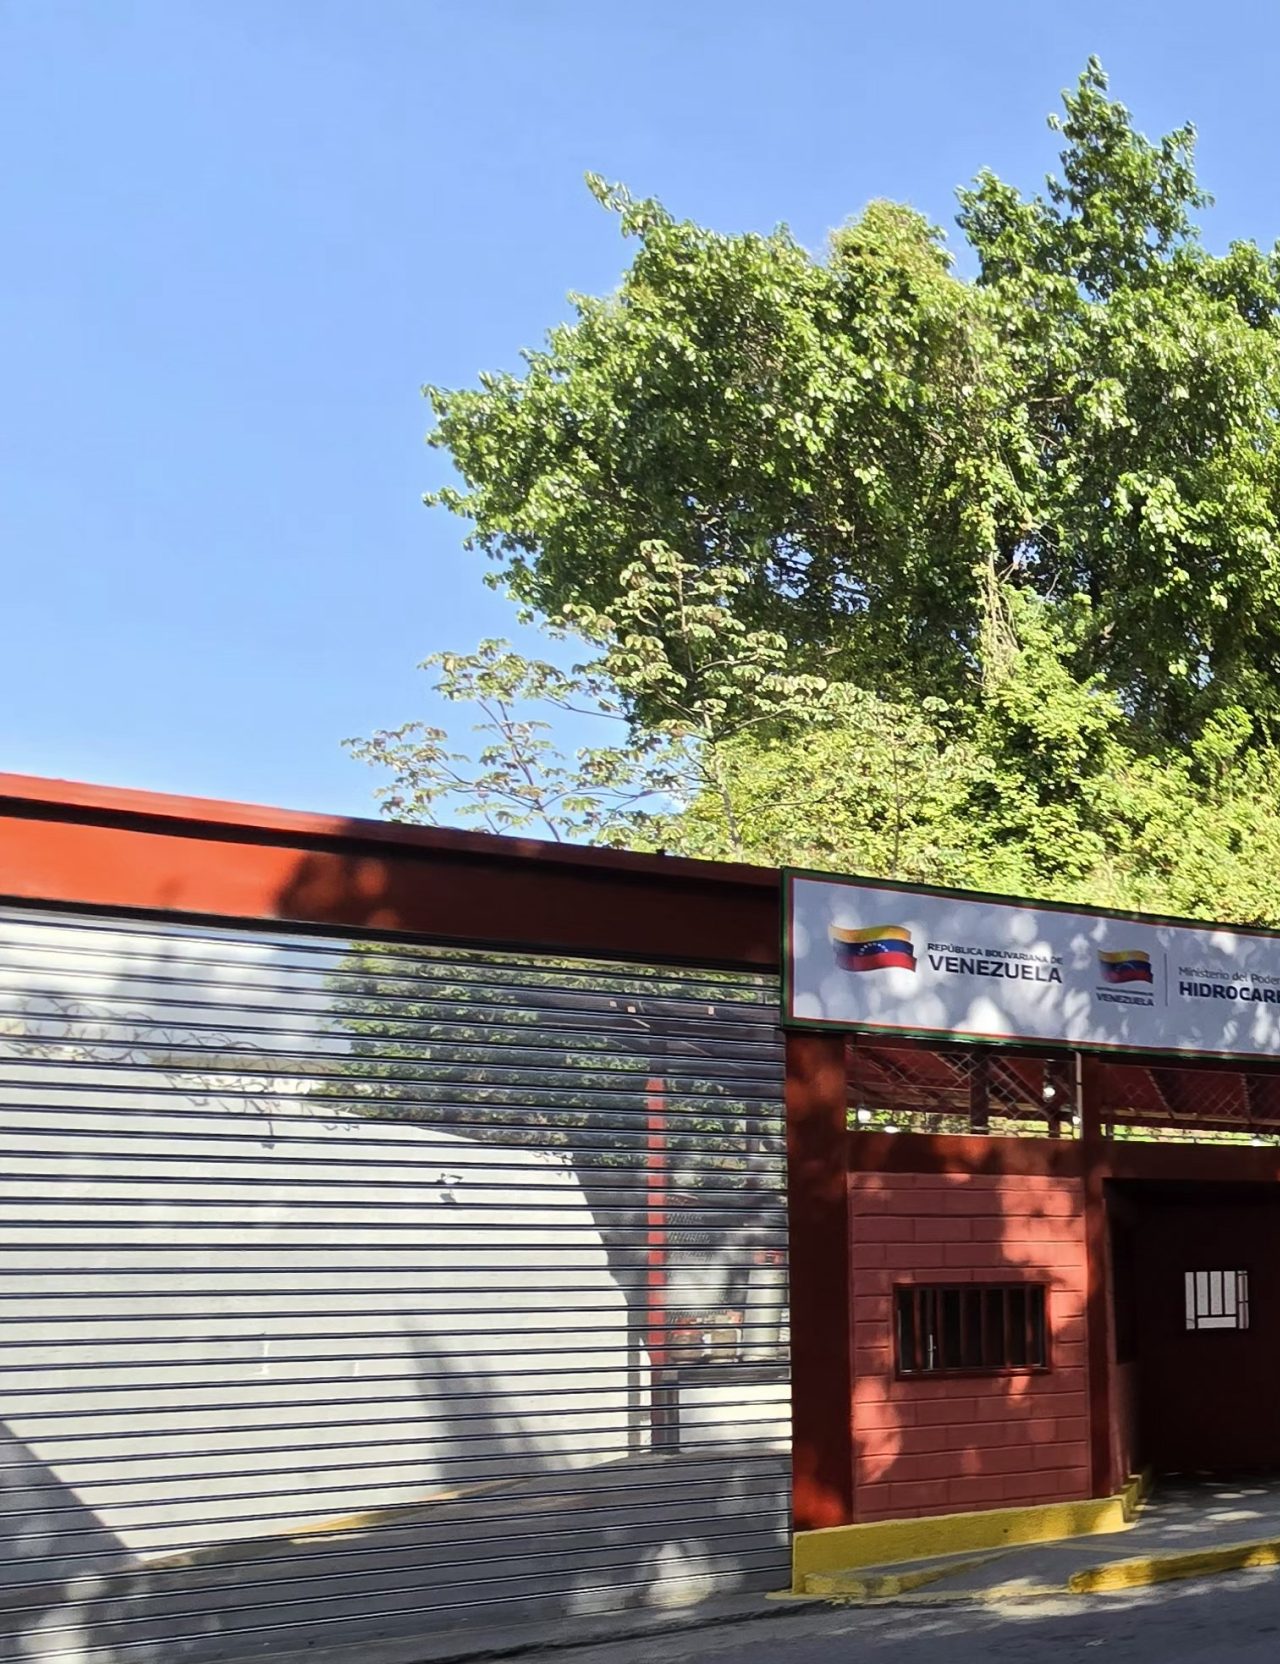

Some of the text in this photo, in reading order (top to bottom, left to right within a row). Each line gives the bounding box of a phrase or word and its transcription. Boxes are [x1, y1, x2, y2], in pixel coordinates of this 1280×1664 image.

[927, 943, 1064, 965] REPÚBLICA BOLIVARIANA DE
[928, 954, 1063, 984] VENEZUELA
[1178, 966, 1230, 981] Ministerio
[1232, 971, 1248, 982] del
[1251, 973, 1280, 985] Poder
